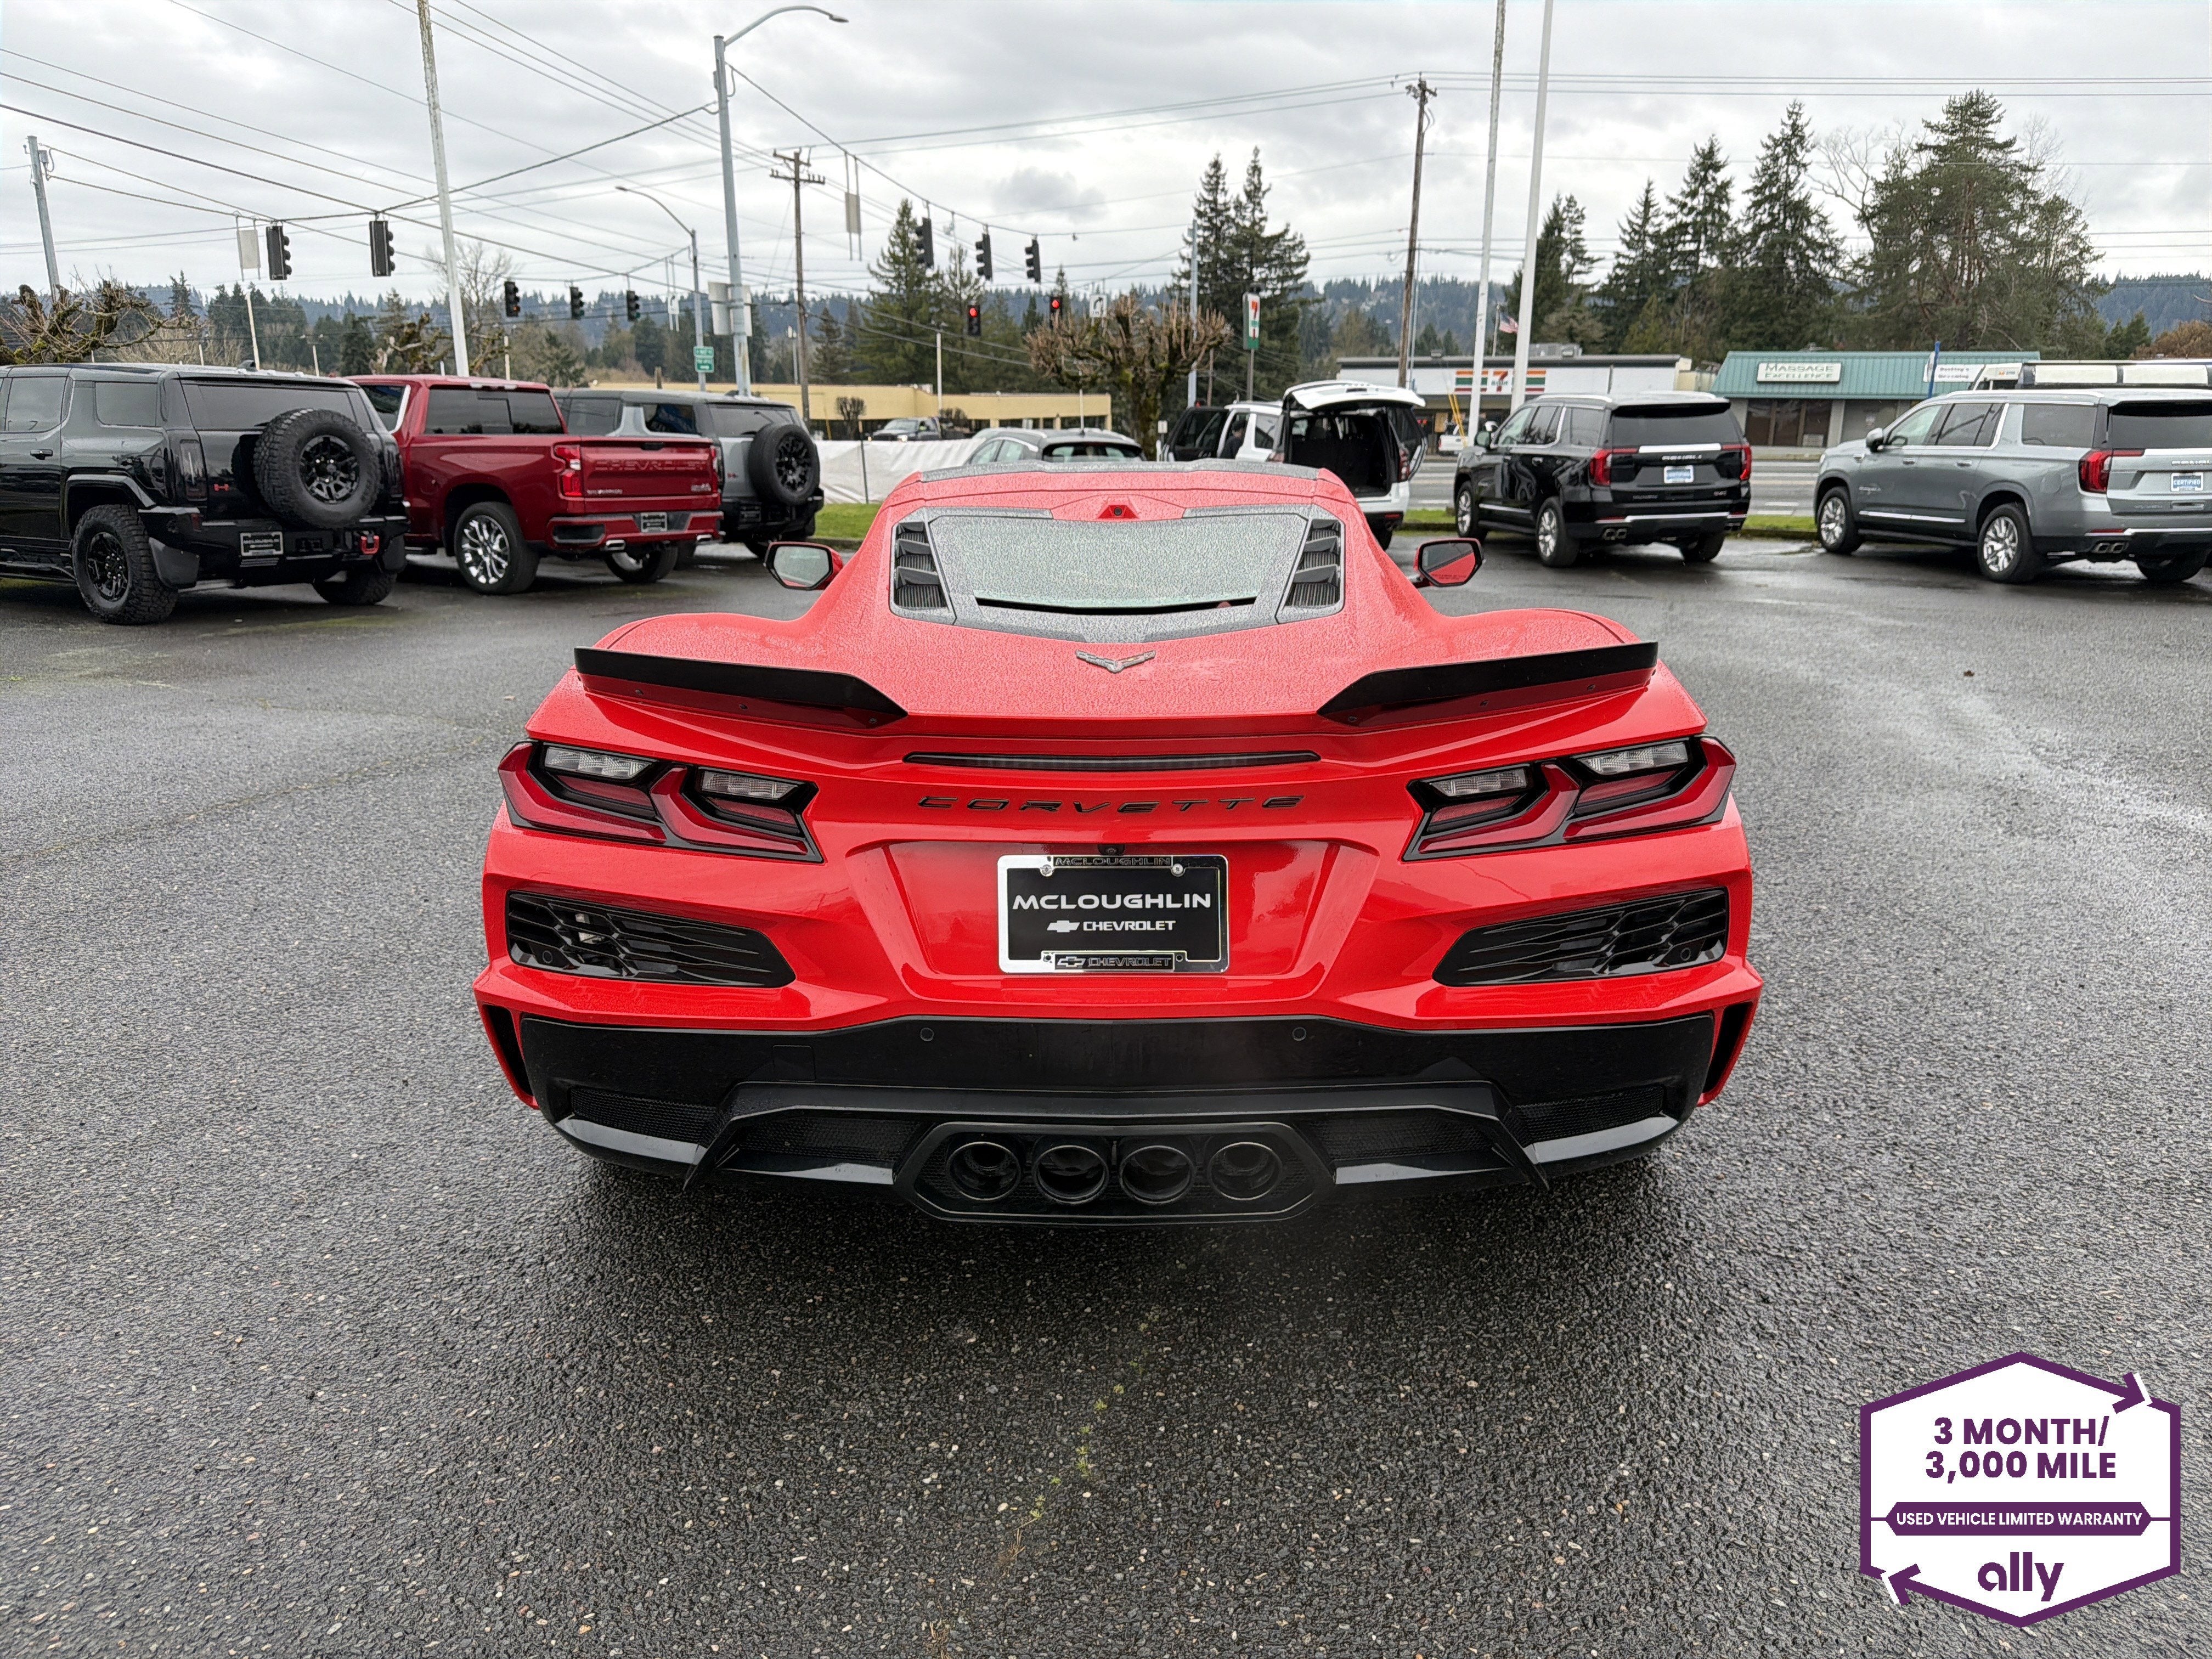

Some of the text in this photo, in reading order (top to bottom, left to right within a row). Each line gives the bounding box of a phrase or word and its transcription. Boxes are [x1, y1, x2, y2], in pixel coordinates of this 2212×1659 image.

[1765, 363, 1834, 373] MASSAGE
[595, 460, 707, 471] CHEVROLET
[918, 795, 1305, 814] CORVETTE
[1054, 857, 1171, 866] MCLOUGHLIN
[1012, 893, 1211, 910] MCLOUGHLIN
[1082, 920, 1177, 932] CHEVROLET
[1088, 957, 1172, 967] CHEVROLET
